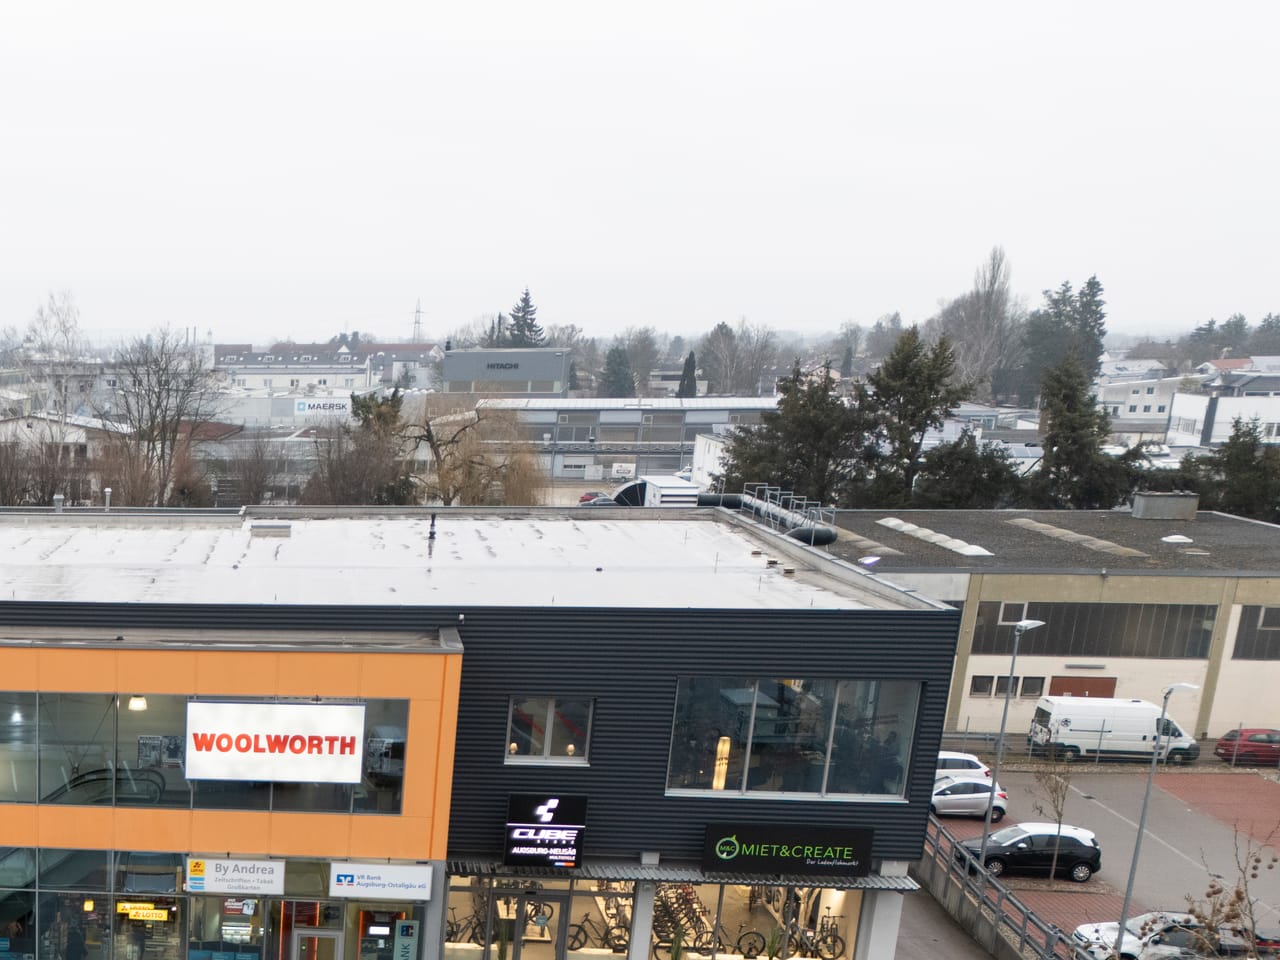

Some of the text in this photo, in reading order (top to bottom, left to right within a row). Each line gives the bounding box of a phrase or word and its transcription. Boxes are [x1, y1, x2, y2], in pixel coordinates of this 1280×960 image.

[307, 403, 348, 411] MAERSK
[192, 732, 357, 755] WOOLWORTH
[511, 828, 579, 840] CUBE
[741, 843, 854, 859] MIET&CREATE
[215, 863, 274, 876] By Andrea
[214, 877, 252, 885] Zeitschriften
